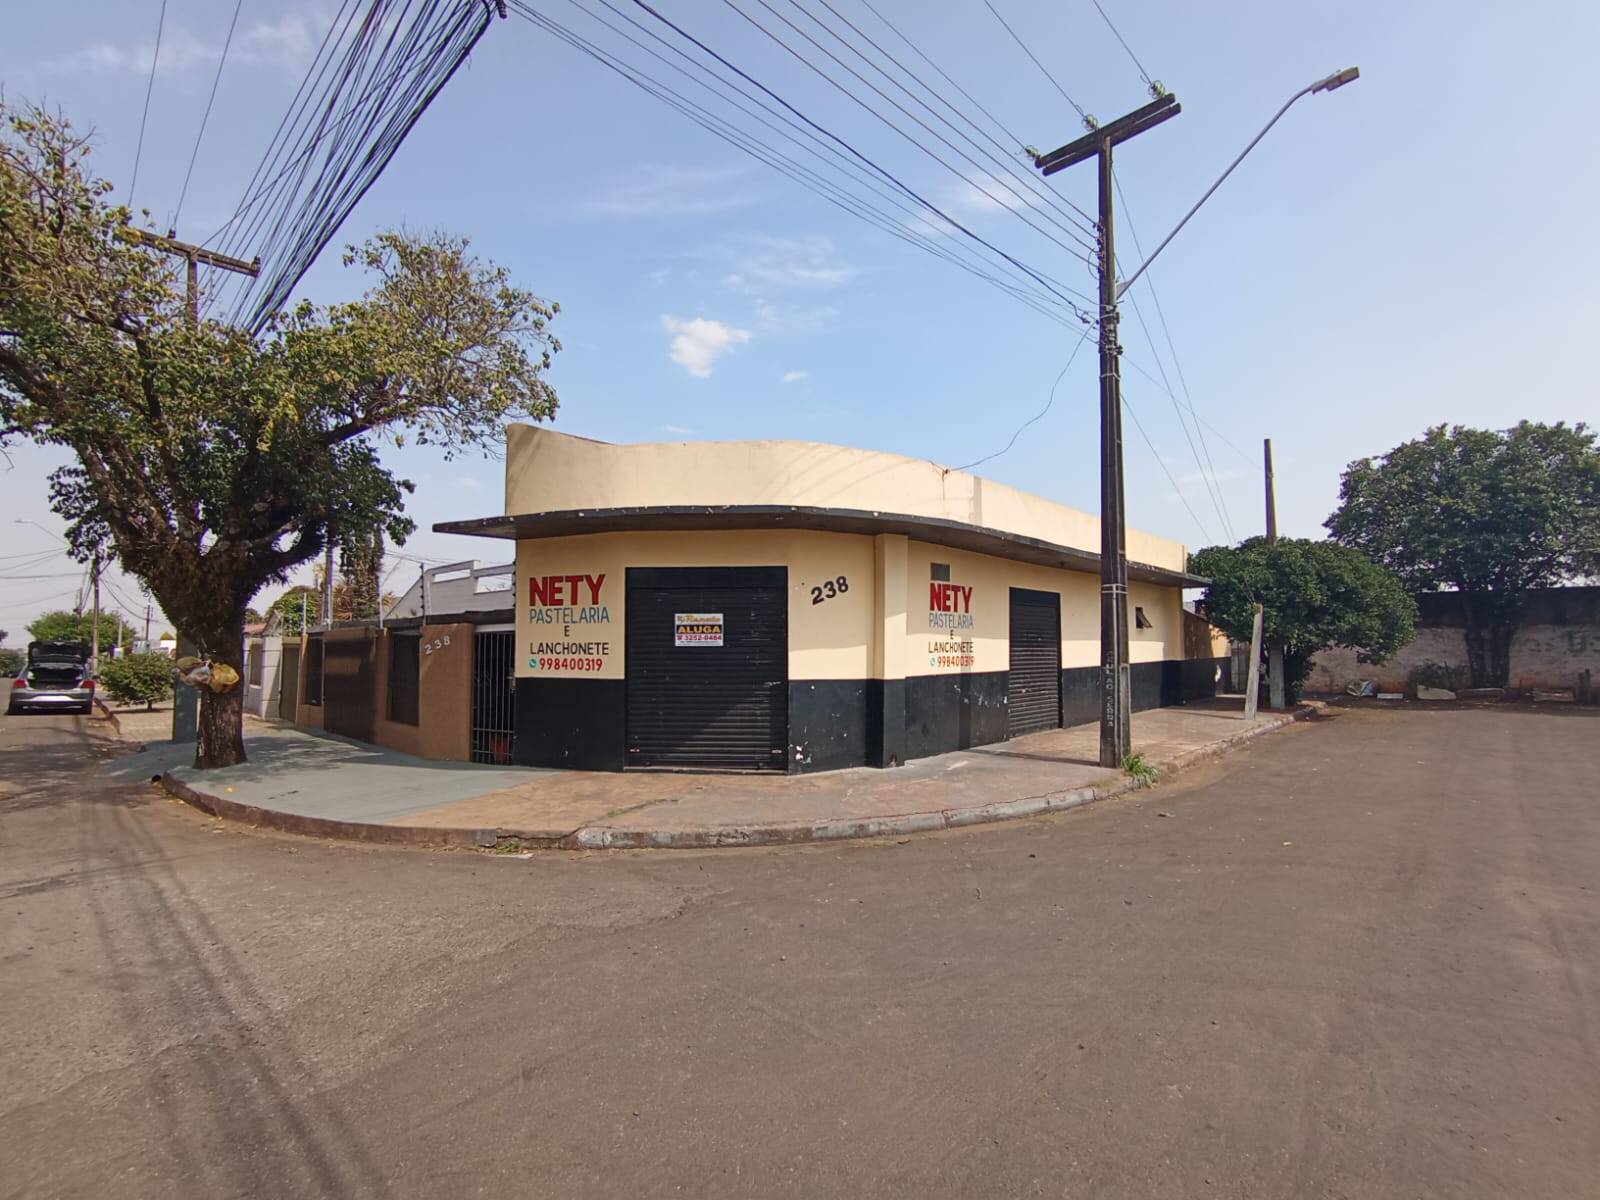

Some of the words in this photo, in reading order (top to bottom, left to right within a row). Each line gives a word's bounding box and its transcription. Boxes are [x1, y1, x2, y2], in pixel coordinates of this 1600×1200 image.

[529, 574, 606, 606] NETY
[811, 575, 849, 605] 238
[929, 582, 973, 613] NETY
[529, 606, 610, 624] PASTELARIA
[928, 613, 974, 629] PASTELARIA
[564, 625, 570, 637] E
[678, 625, 721, 634] ALUGA
[950, 629, 955, 639] E
[424, 635, 451, 655] 238
[530, 642, 609, 655] LANCHONETE
[928, 641, 974, 653] LANCHONETE
[539, 658, 603, 671] 998400319
